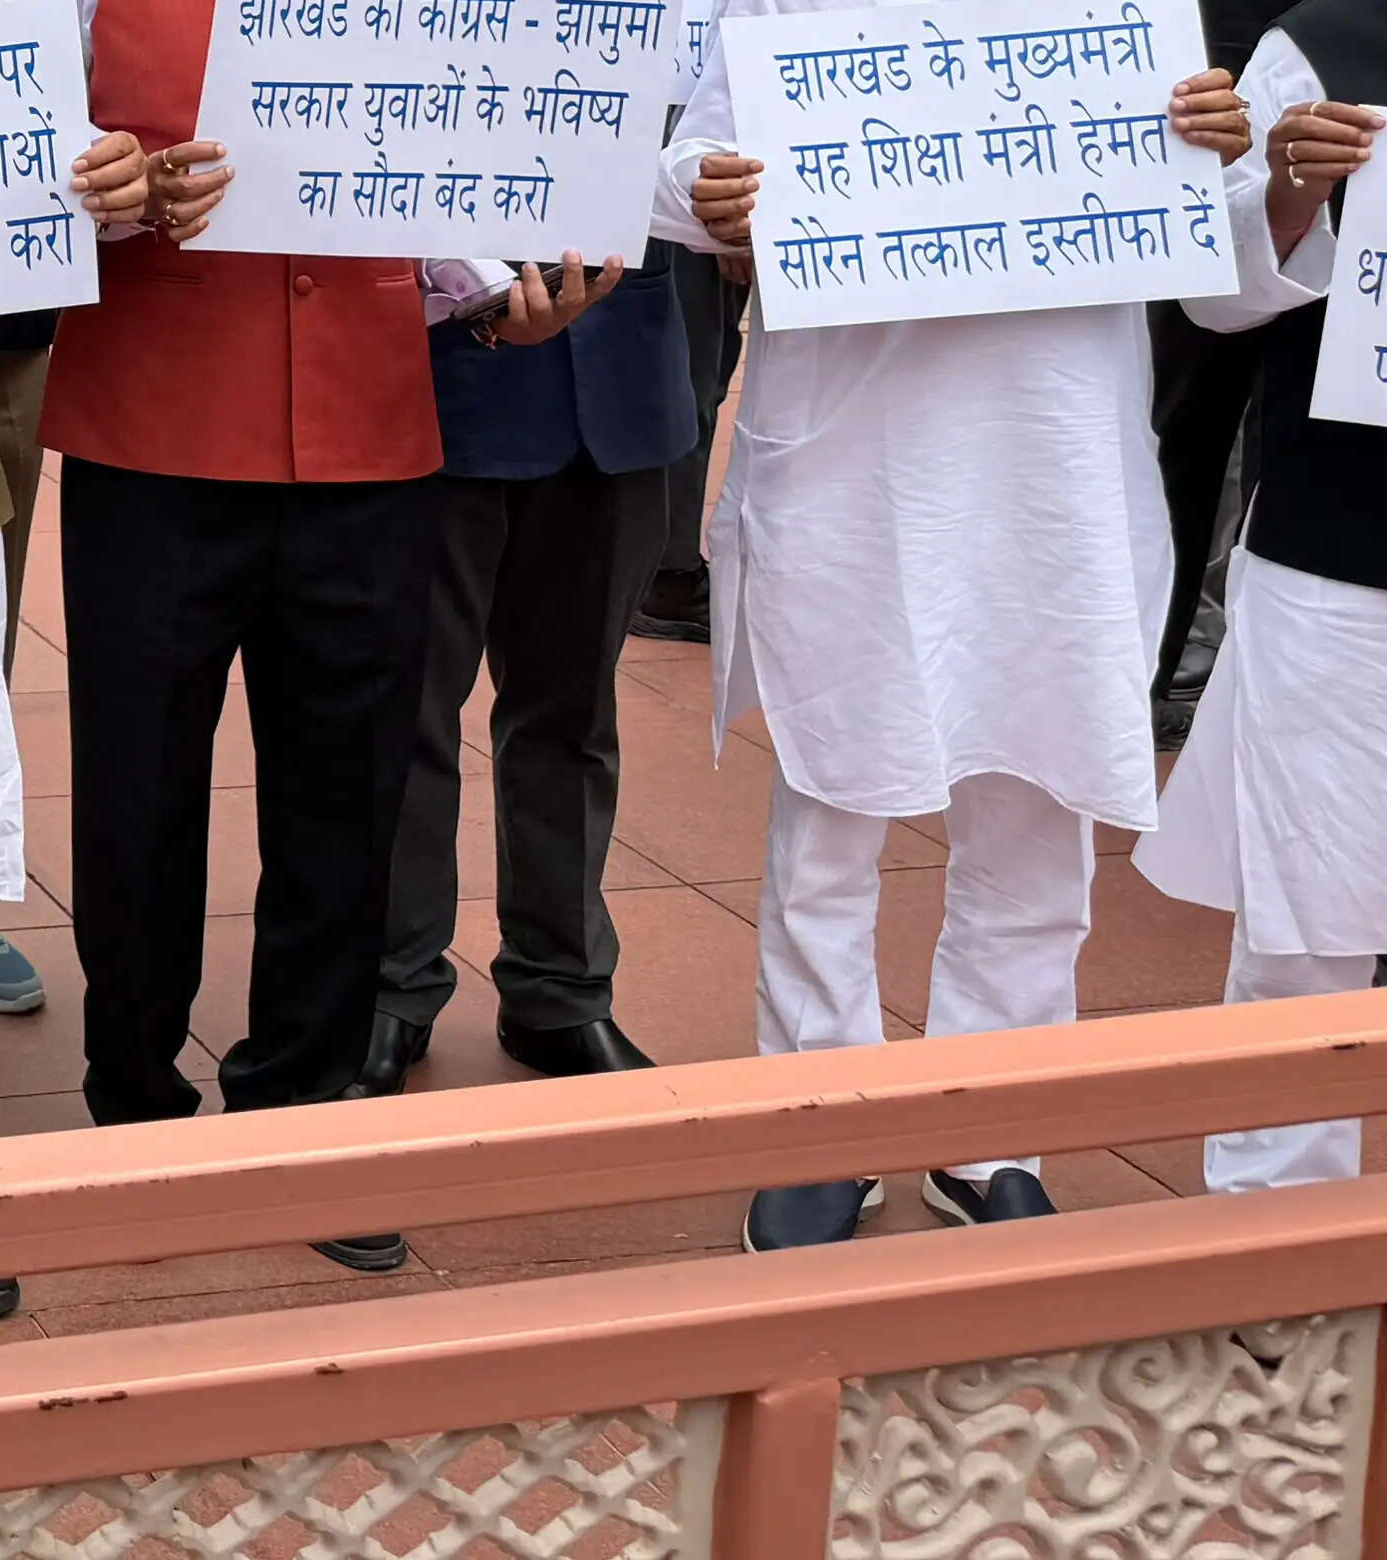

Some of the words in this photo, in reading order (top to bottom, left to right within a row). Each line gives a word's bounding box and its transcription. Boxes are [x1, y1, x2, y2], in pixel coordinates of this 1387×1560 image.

[773, 32, 911, 111] झारखंड
[922, 20, 965, 90] के
[977, 2, 1155, 102] मुख्यमंत्री
[251, 82, 353, 129] सरकार
[363, 64, 466, 146] युवाओं
[476, 65, 510, 131] के
[523, 69, 629, 139] भविष्य
[789, 142, 851, 199] सह
[861, 118, 964, 189] शिक्षा
[975, 104, 1057, 178] मंत्री
[1069, 100, 1171, 177] हेमंत
[5, 192, 75, 270] करो
[299, 171, 343, 217] का
[352, 151, 425, 221] सौदा
[435, 158, 483, 223] बंद
[493, 156, 554, 223] करो
[773, 216, 865, 290] सोरेन
[875, 222, 1008, 280] तत्काल
[1019, 192, 1170, 276] इस्तीफा
[1182, 184, 1219, 257] दें
